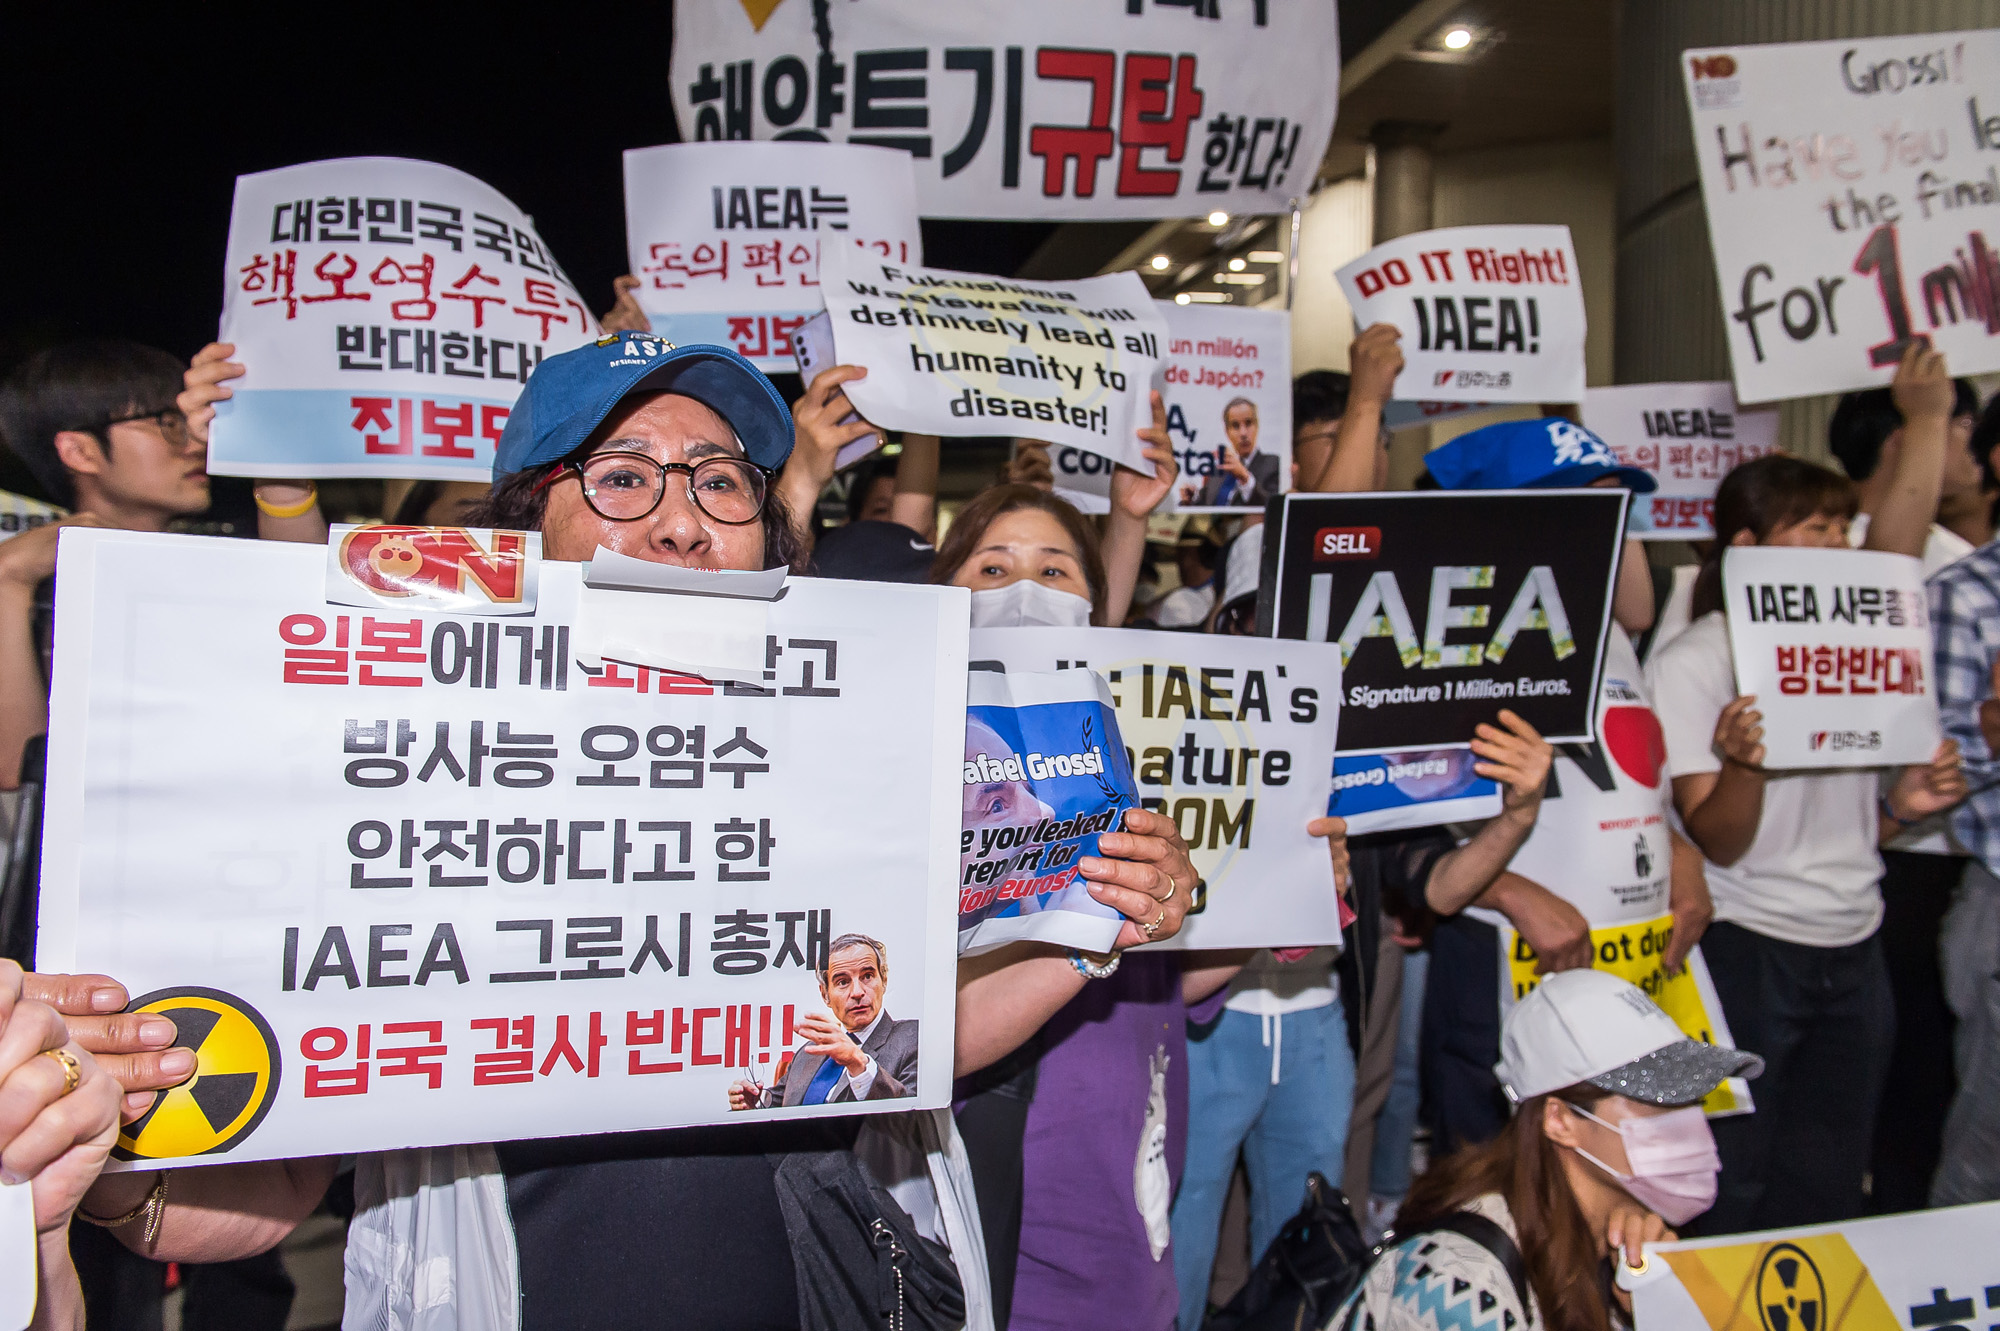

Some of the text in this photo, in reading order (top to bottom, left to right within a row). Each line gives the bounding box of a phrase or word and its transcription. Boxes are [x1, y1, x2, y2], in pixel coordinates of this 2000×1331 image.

[269, 196, 465, 253] 대한민국
[711, 186, 849, 231] IAEA는
[1820, 188, 1903, 232] the
[880, 265, 1077, 302] Fukushima
[1354, 247, 1570, 299] DO IT Right!
[850, 304, 1159, 361] definitely lead all
[1077, 306, 1136, 323] will
[1412, 295, 1541, 355] IAEA!
[1732, 262, 1846, 364] for
[726, 314, 808, 360] 진보
[1196, 335, 1259, 360] millón
[911, 343, 1126, 392] humanity to
[1164, 364, 1265, 390] de Japón?
[949, 387, 1108, 437] disaster!
[1642, 407, 1736, 440] IAEA는
[1322, 533, 1371, 555] SELL
[1306, 564, 1577, 670] IAEA
[1745, 583, 1822, 624] IAEA
[277, 612, 571, 693] 일본에게
[1349, 683, 1442, 709] Signature
[1444, 680, 1453, 700] 1
[1454, 678, 1514, 700] Million
[1515, 676, 1572, 697] Euros.
[343, 718, 772, 790] 방사능 오염수
[963, 745, 1105, 785] afael Grossi
[346, 816, 777, 890] 안전하다고 한
[975, 824, 1034, 859] you
[1031, 806, 1116, 846] leaked
[962, 841, 1081, 887] report for
[996, 864, 1080, 901] euros?
[281, 908, 832, 993] IAEA 그로시 총재
[299, 1002, 798, 1099] 입국 결사 반대!!
